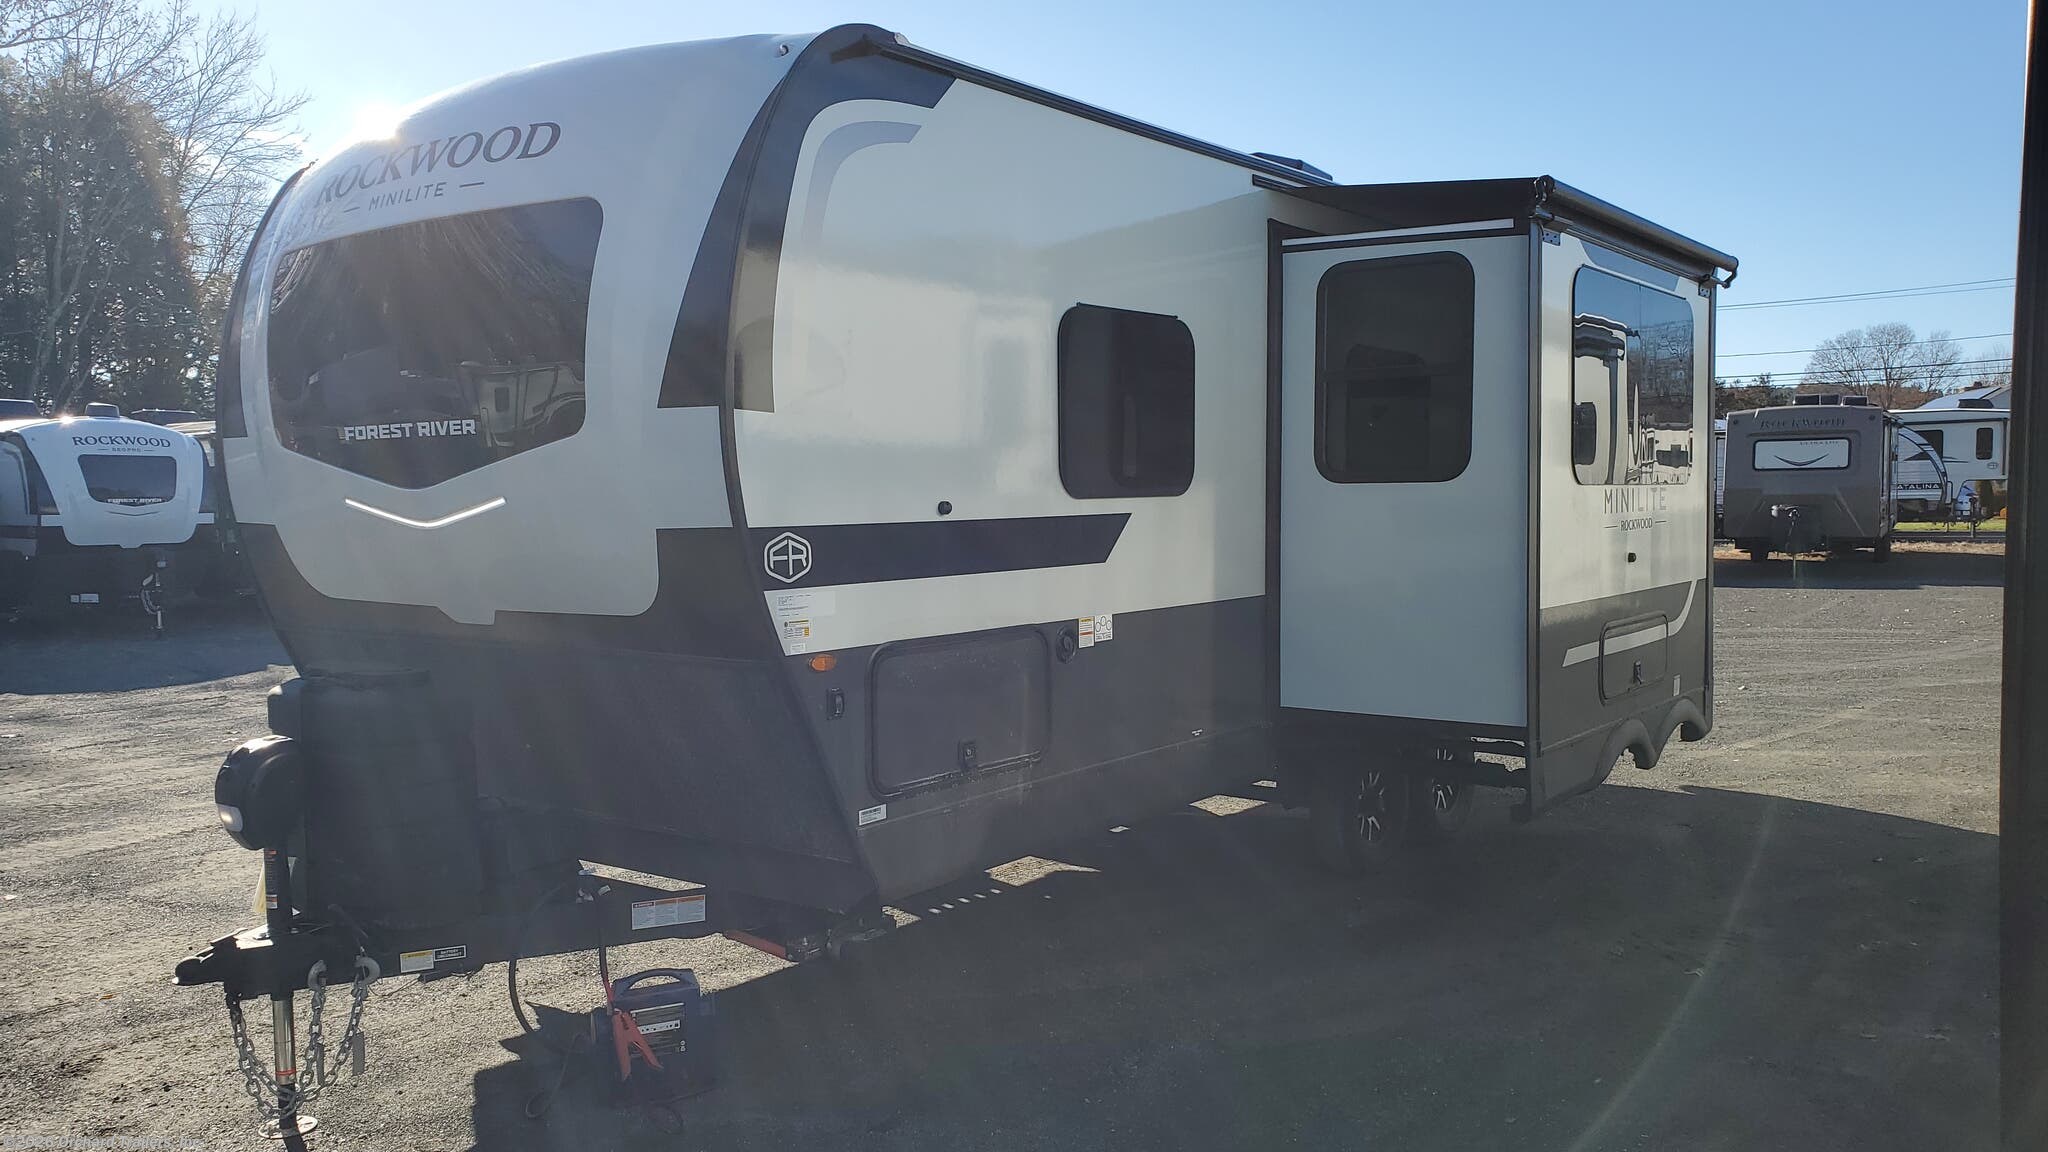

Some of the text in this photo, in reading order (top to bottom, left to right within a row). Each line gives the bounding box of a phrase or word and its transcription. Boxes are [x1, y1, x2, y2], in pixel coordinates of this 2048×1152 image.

[315, 121, 562, 209] ROCKWOOD
[367, 181, 448, 212] MINILITE
[72, 435, 171, 448] ROCKWOOD
[343, 419, 477, 441] FOREST RIVER
[1603, 487, 1667, 514] MINILITE
[1620, 517, 1653, 531] ROCKWOOD
